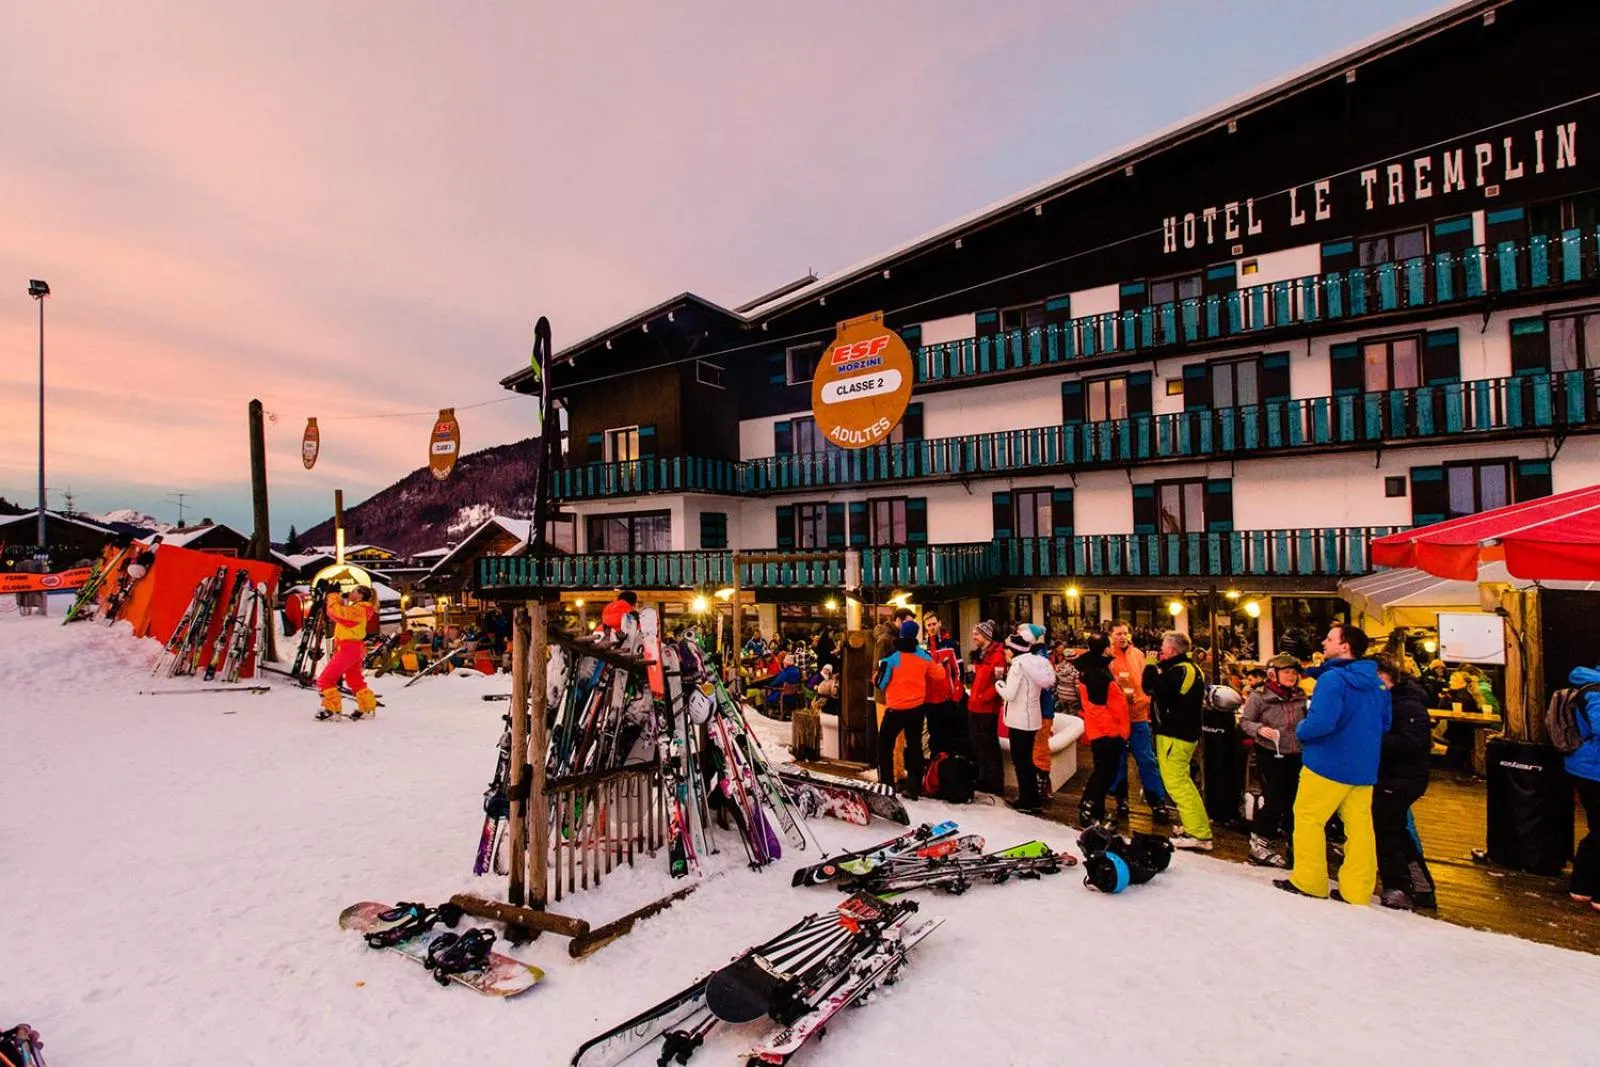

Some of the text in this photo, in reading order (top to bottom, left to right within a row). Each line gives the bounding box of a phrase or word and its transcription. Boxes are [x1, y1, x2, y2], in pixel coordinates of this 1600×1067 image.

[1163, 122, 1577, 253] HOTEL LE TREMPLIN
[831, 335, 890, 365] ESF
[838, 358, 883, 372] MORZINE
[836, 378, 884, 395] CLASSE 2
[831, 417, 891, 443] ADULTES
